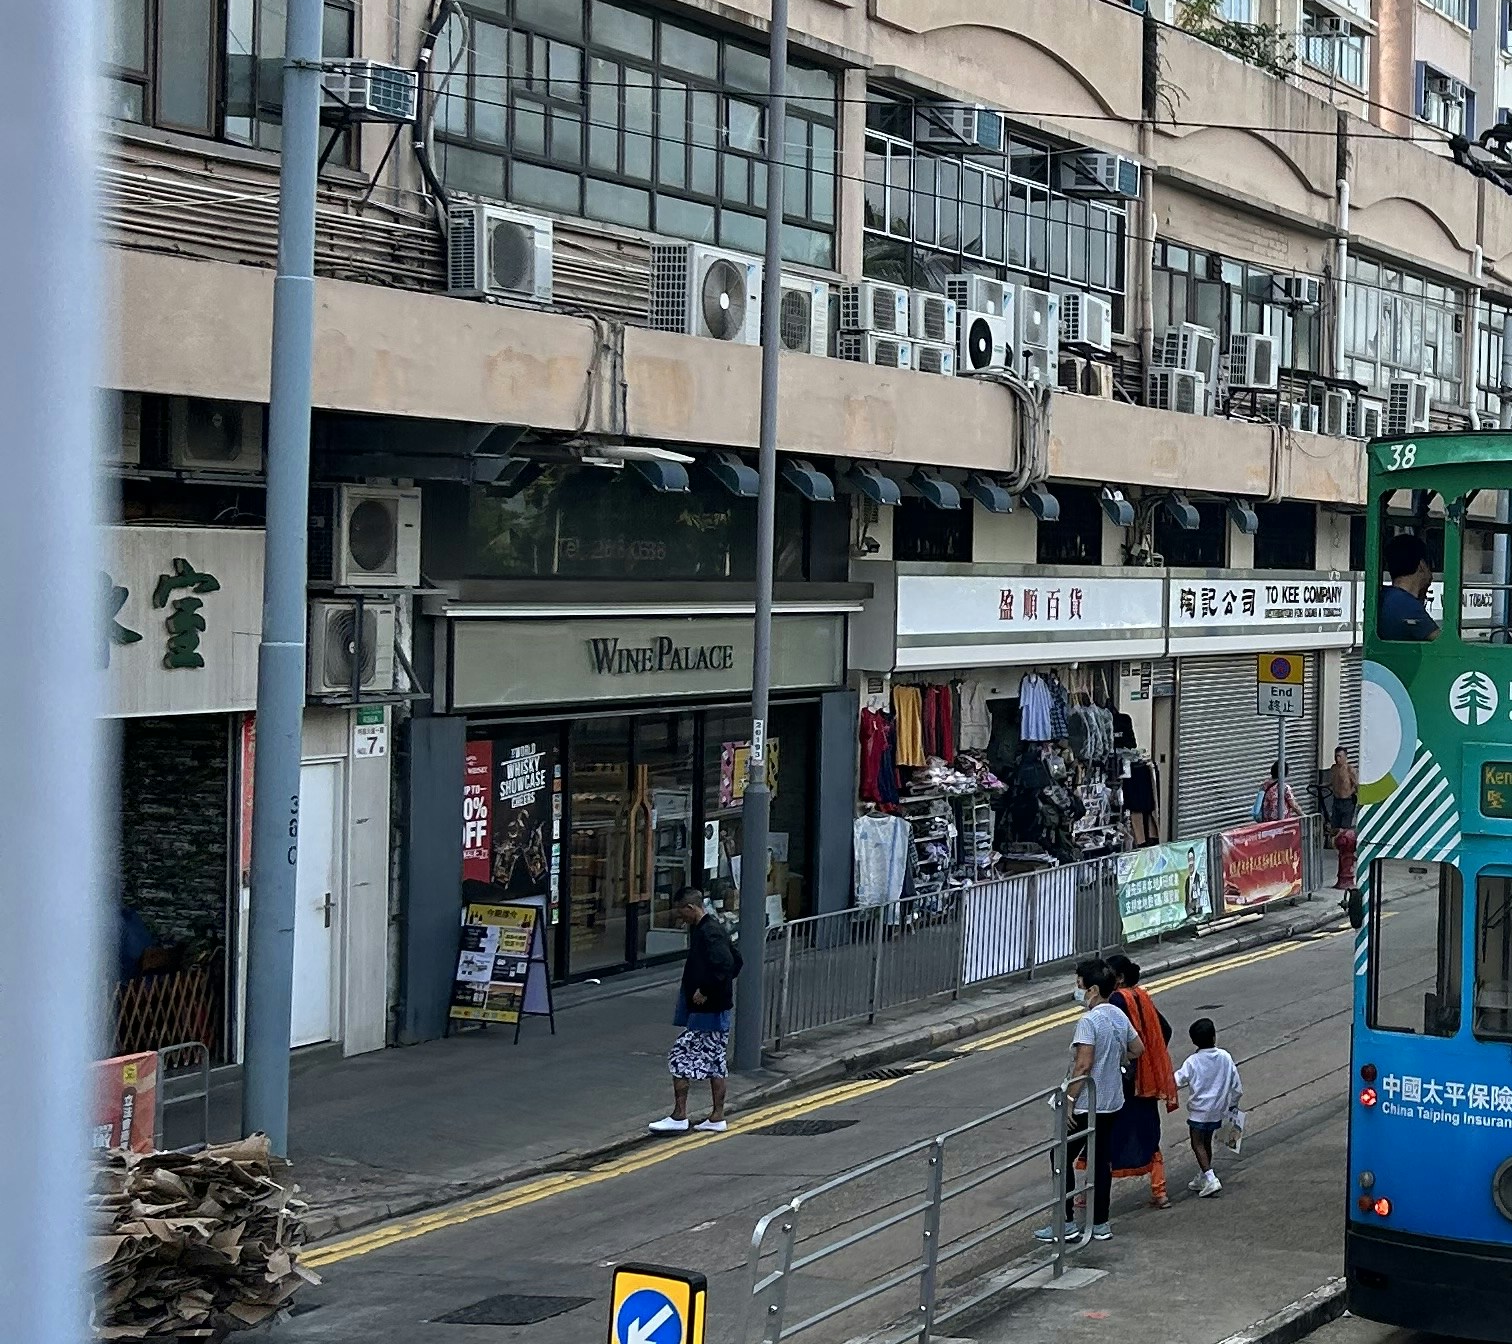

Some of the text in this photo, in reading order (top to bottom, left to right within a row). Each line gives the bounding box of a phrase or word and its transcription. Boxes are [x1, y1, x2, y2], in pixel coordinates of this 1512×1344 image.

[1387, 443, 1417, 470] 38
[999, 588, 1082, 620] 盈順百貨
[1180, 588, 1256, 618] 陶記公司
[1265, 586, 1342, 604] TO KEE COMPANY
[587, 636, 734, 675] WINE PALACE
[1271, 686, 1292, 697] End
[1268, 699, 1294, 714] 終止
[367, 736, 378, 755] 7
[506, 756, 541, 779] WHISKY
[500, 769, 546, 797] SHOWCASE
[463, 796, 488, 820] 0%
[463, 819, 487, 848] FF
[1382, 1101, 1414, 1119] China
[1417, 1105, 1460, 1127] Taiping
